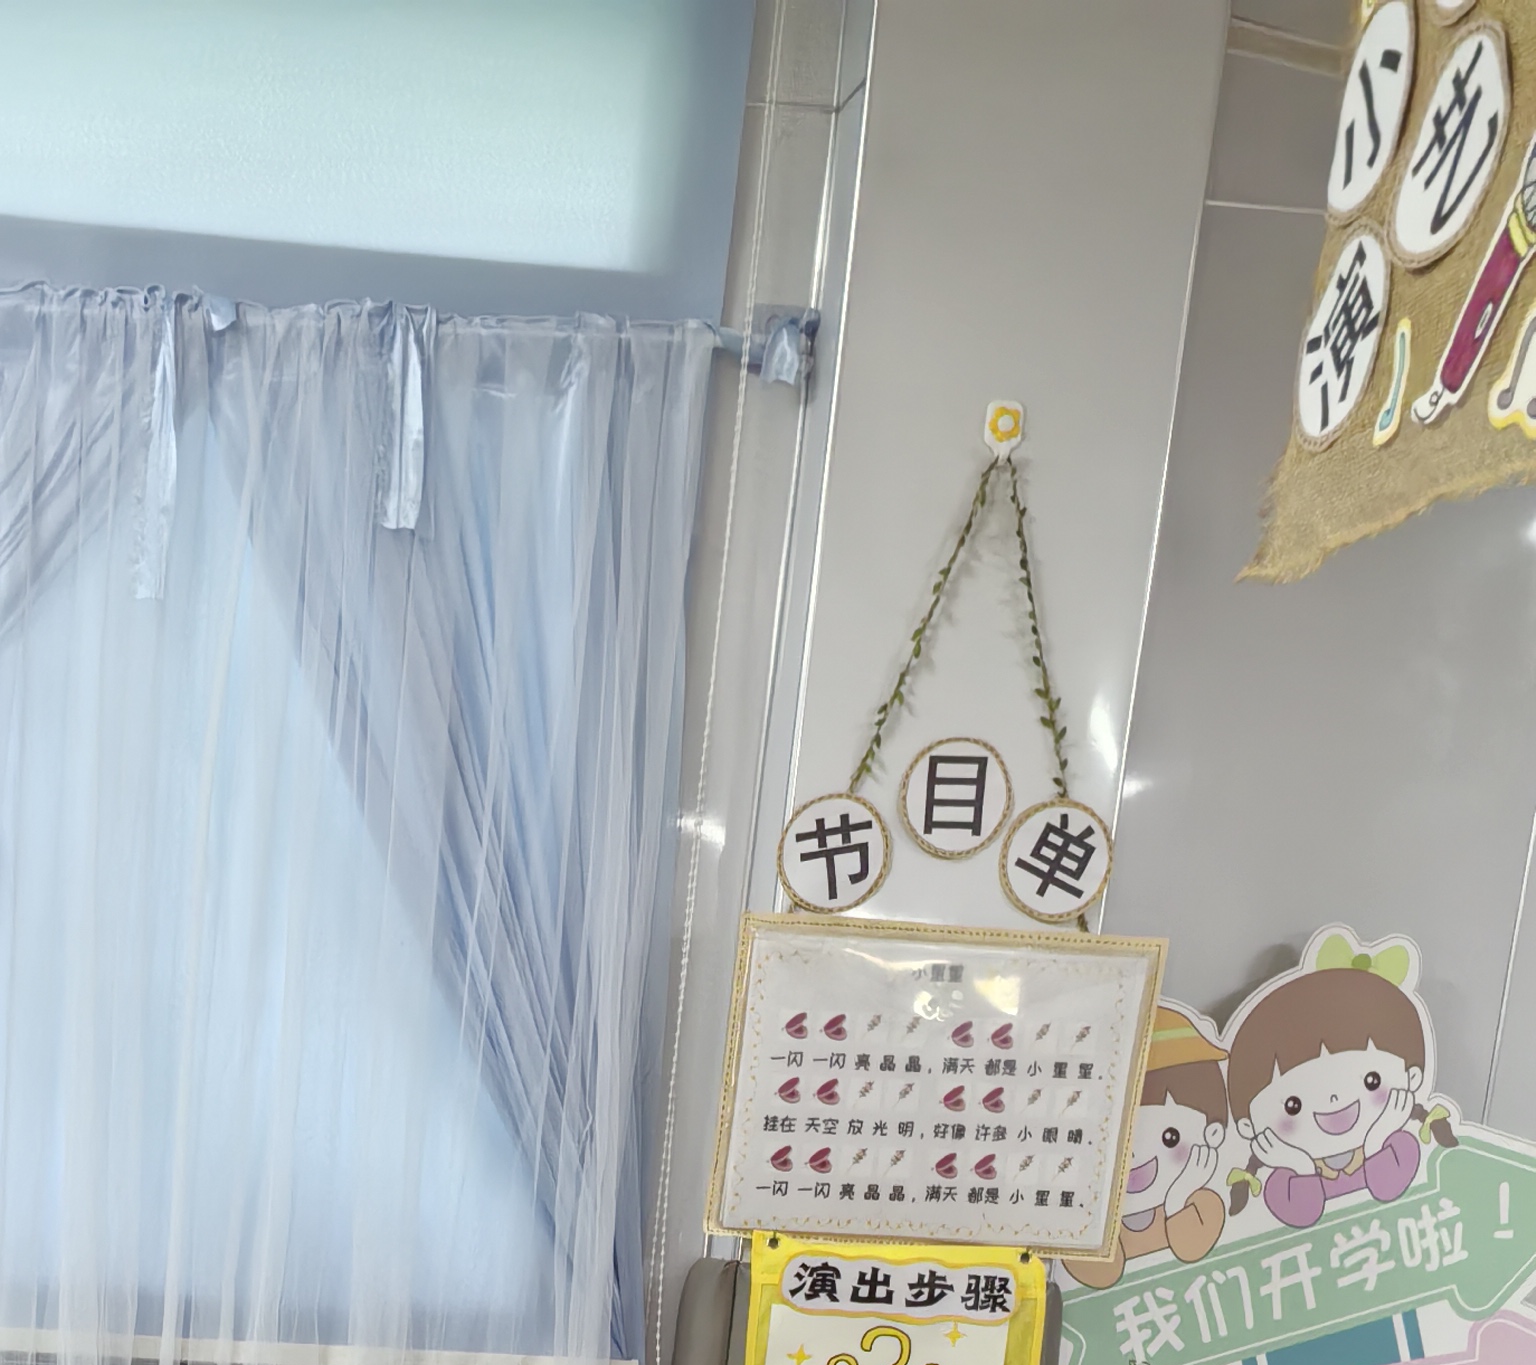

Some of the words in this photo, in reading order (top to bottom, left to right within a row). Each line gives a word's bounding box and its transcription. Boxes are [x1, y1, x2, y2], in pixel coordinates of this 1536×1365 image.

[1342, 48, 1402, 192] 小
[795, 755, 1097, 900] 节目单
[787, 1261, 1014, 1313] 演出步骤
